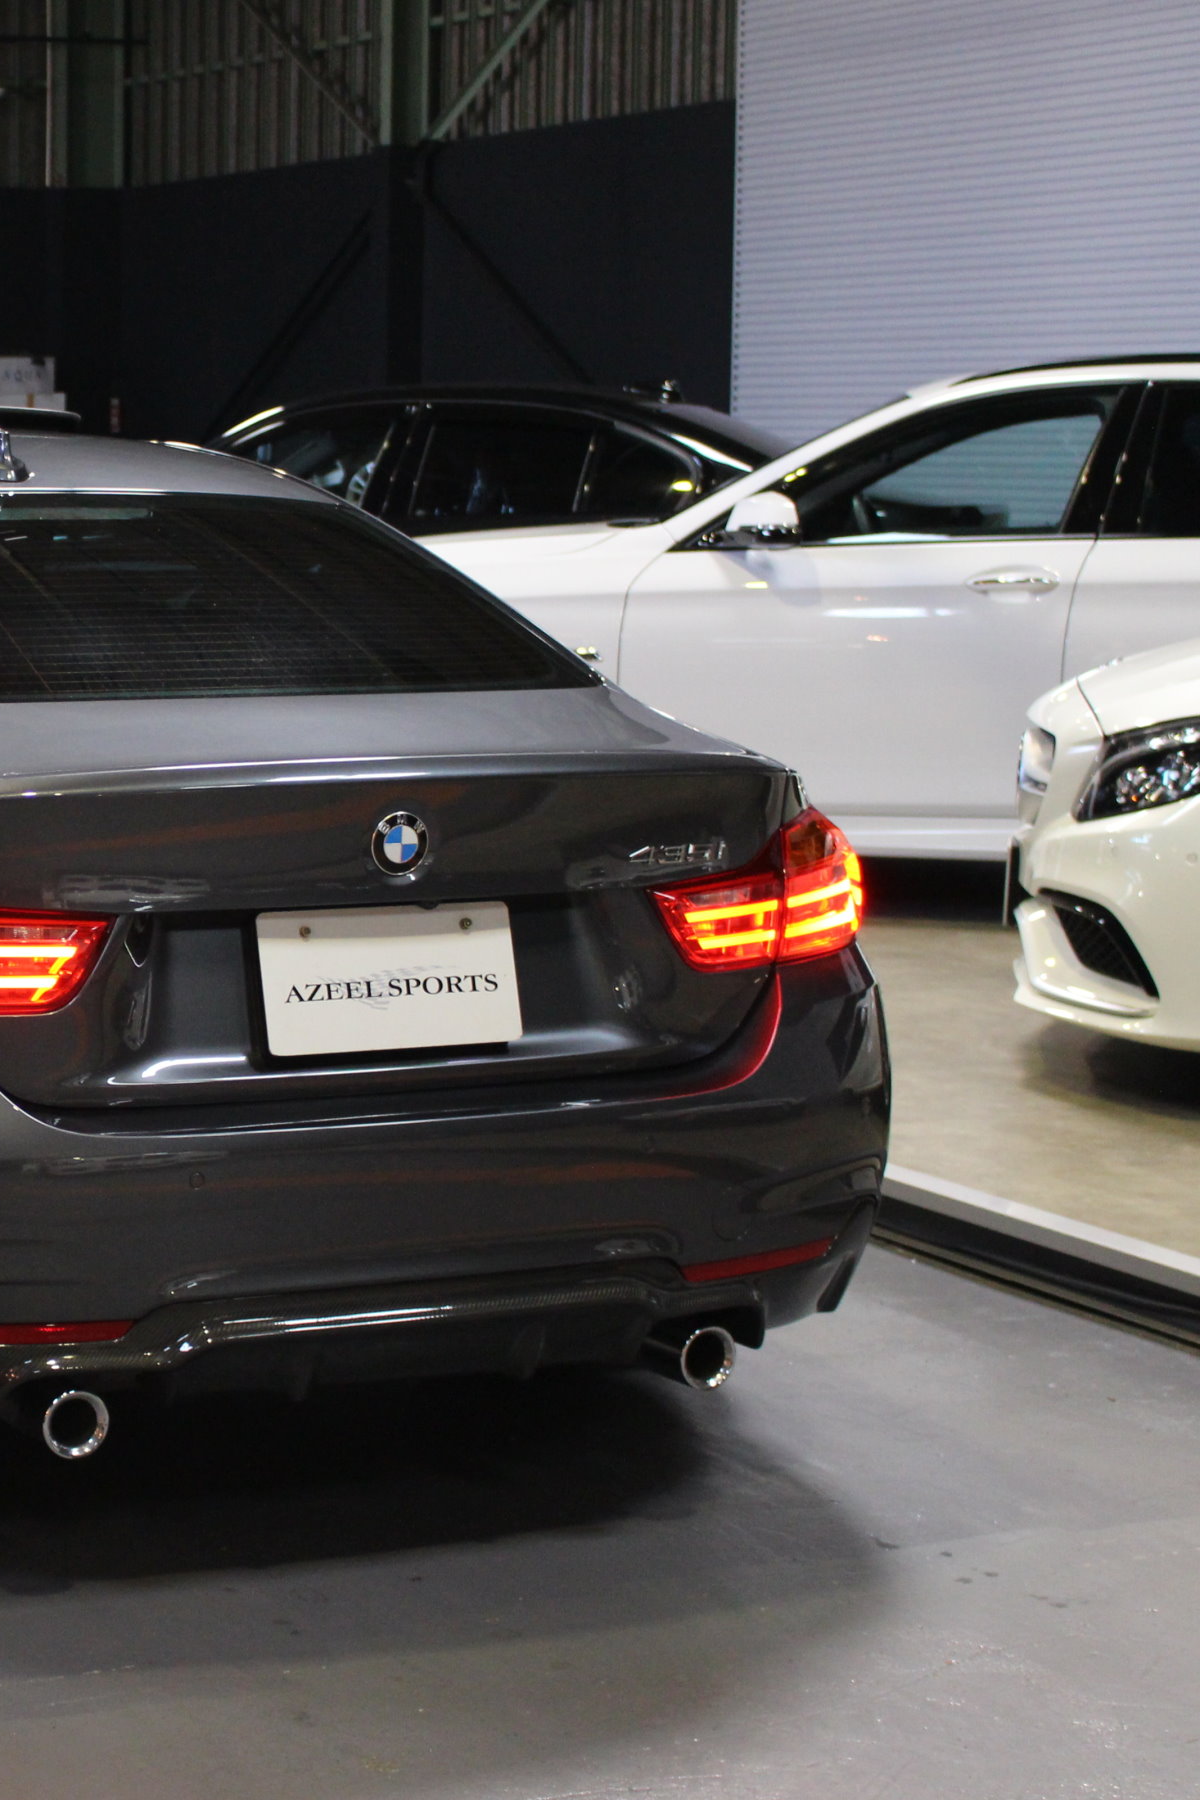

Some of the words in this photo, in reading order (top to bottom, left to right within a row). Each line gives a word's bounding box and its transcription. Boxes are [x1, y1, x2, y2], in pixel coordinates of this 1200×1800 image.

[378, 814, 425, 835] BMW
[285, 981, 383, 1004] AZEEL
[388, 974, 499, 997] SPORTS
